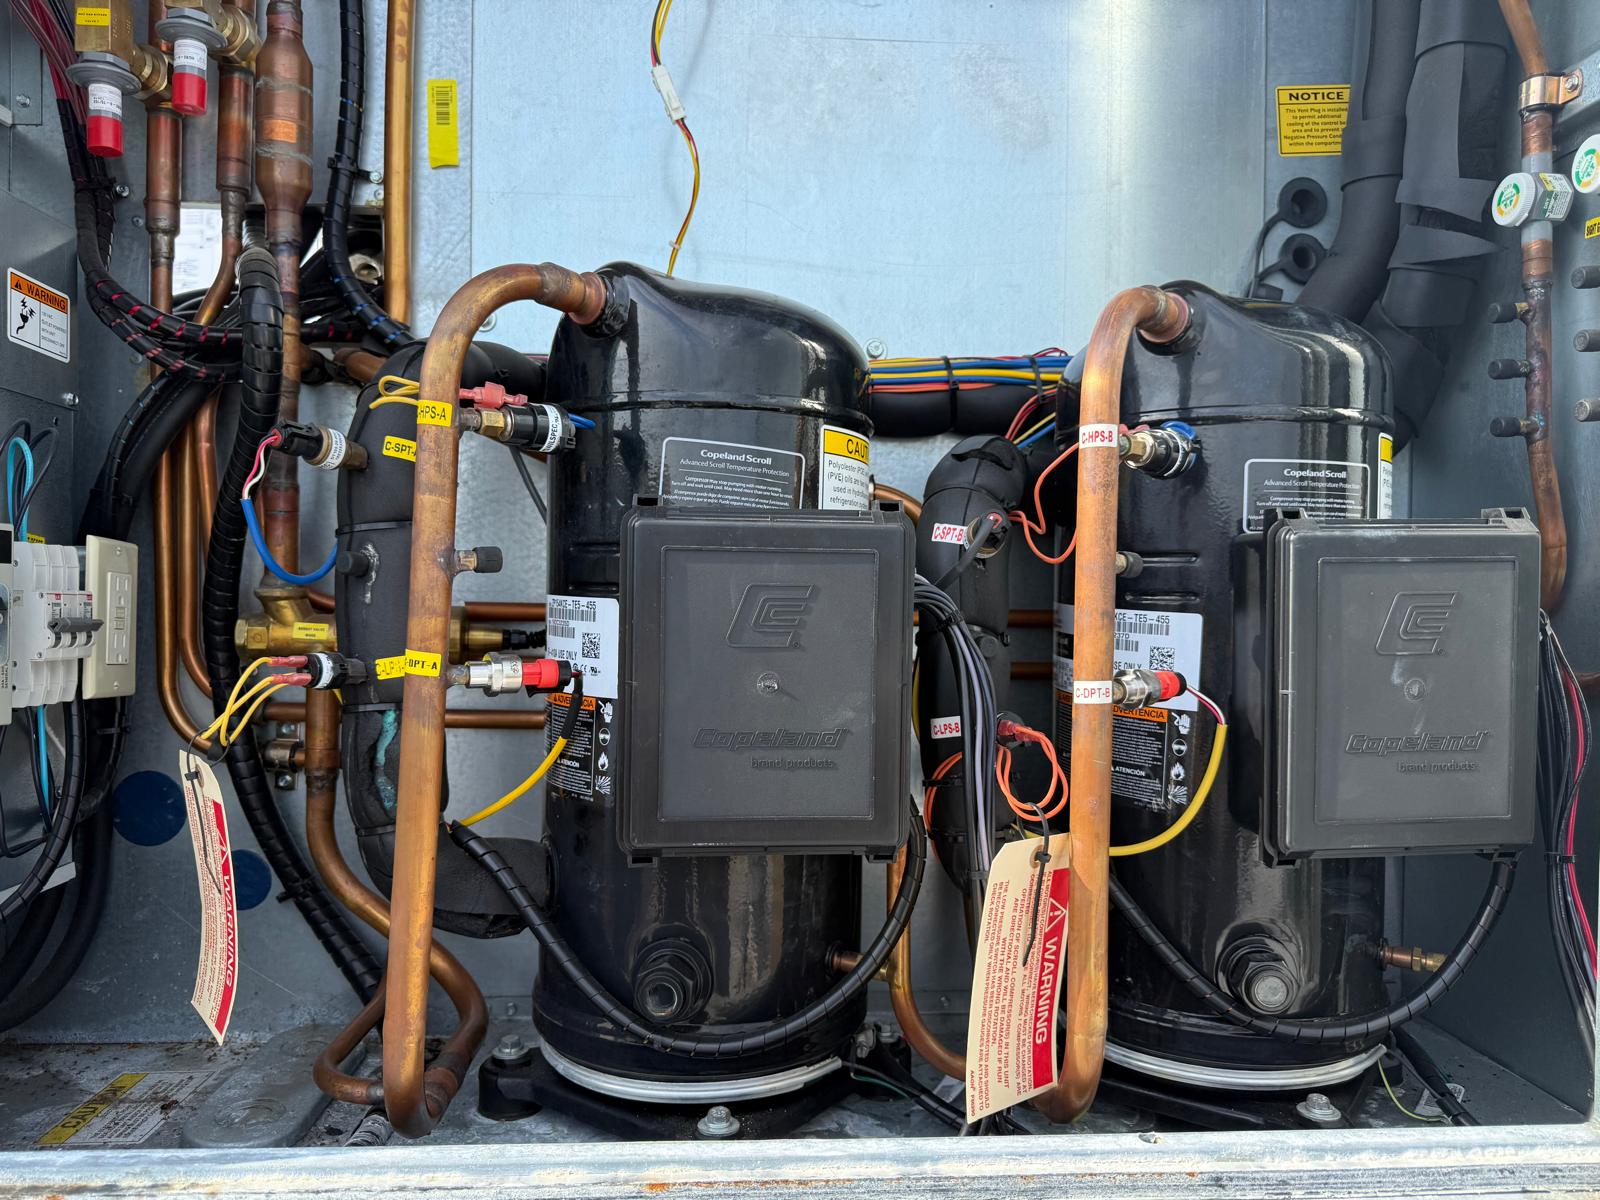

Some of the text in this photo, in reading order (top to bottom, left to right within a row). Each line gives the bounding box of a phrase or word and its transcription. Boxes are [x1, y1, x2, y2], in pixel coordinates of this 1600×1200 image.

[1288, 90, 1343, 101] NOTICE
[27, 282, 66, 310] WARNING
[418, 406, 446, 420] -HPS-A
[1081, 432, 1114, 445] C-HPS-B
[385, 441, 416, 457] C-SPT-
[700, 449, 771, 464] Copeland Scroll
[679, 457, 708, 466] Advanced
[725, 463, 761, 473] Temperature
[762, 467, 789, 476] Protection
[828, 460, 856, 472] Polyolester
[1283, 468, 1346, 478] Copeland Scroll
[828, 472, 844, 483] (PVE)
[833, 486, 846, 494] used
[933, 525, 963, 541] C-SPT-B
[405, 658, 437, 670] -DPT-A
[1076, 688, 1111, 698] C-DPT-B
[1114, 705, 1164, 719] DVERTENCIA
[933, 723, 960, 735] C-LPS-B
[693, 728, 846, 750] Copeland
[1346, 732, 1484, 756] Copeland
[751, 757, 833, 770] brand products
[1116, 766, 1145, 776] ATENCIÓN
[1397, 760, 1477, 774] brand products
[997, 881, 1003, 890] BE
[984, 882, 997, 943] CHECK ROTATION.
[989, 891, 1001, 941] RECONNECTED
[1016, 888, 1026, 930] OPERATION
[222, 875, 237, 987] WARNING
[995, 911, 1003, 946] PRESSURE
[1015, 932, 1019, 942] OF
[1005, 914, 1016, 965] DIRECTIONAL
[1010, 944, 1018, 975] SCROLL
[994, 975, 1002, 1004] WRONG
[1035, 935, 1057, 1044] WARNING
[981, 982, 989, 1017] PRESSURE
[1004, 977, 1015, 1039] COMPRESSOR(S)
[1000, 1004, 1005, 1014] BE
[990, 1006, 999, 1046] ROTATION.
[983, 1009, 992, 1062] DISCONNECTED
[996, 1016, 1005, 1055] DAMAGED
[1021, 1038, 1026, 1048] BE
[1004, 1041, 1009, 1049] IN
[1012, 1023, 1024, 1079] COMPRESSOR(S)
[1019, 1050, 1027, 1082] CHANGED
[1023, 1055, 1034, 1092] ROTATION.
[975, 1063, 984, 1100] ATTACHED
[1002, 1070, 1010, 1088] UNIT
[982, 1079, 991, 1108] SHOULD
[1022, 1084, 1027, 1093] AT
[979, 1101, 983, 1110] TO
